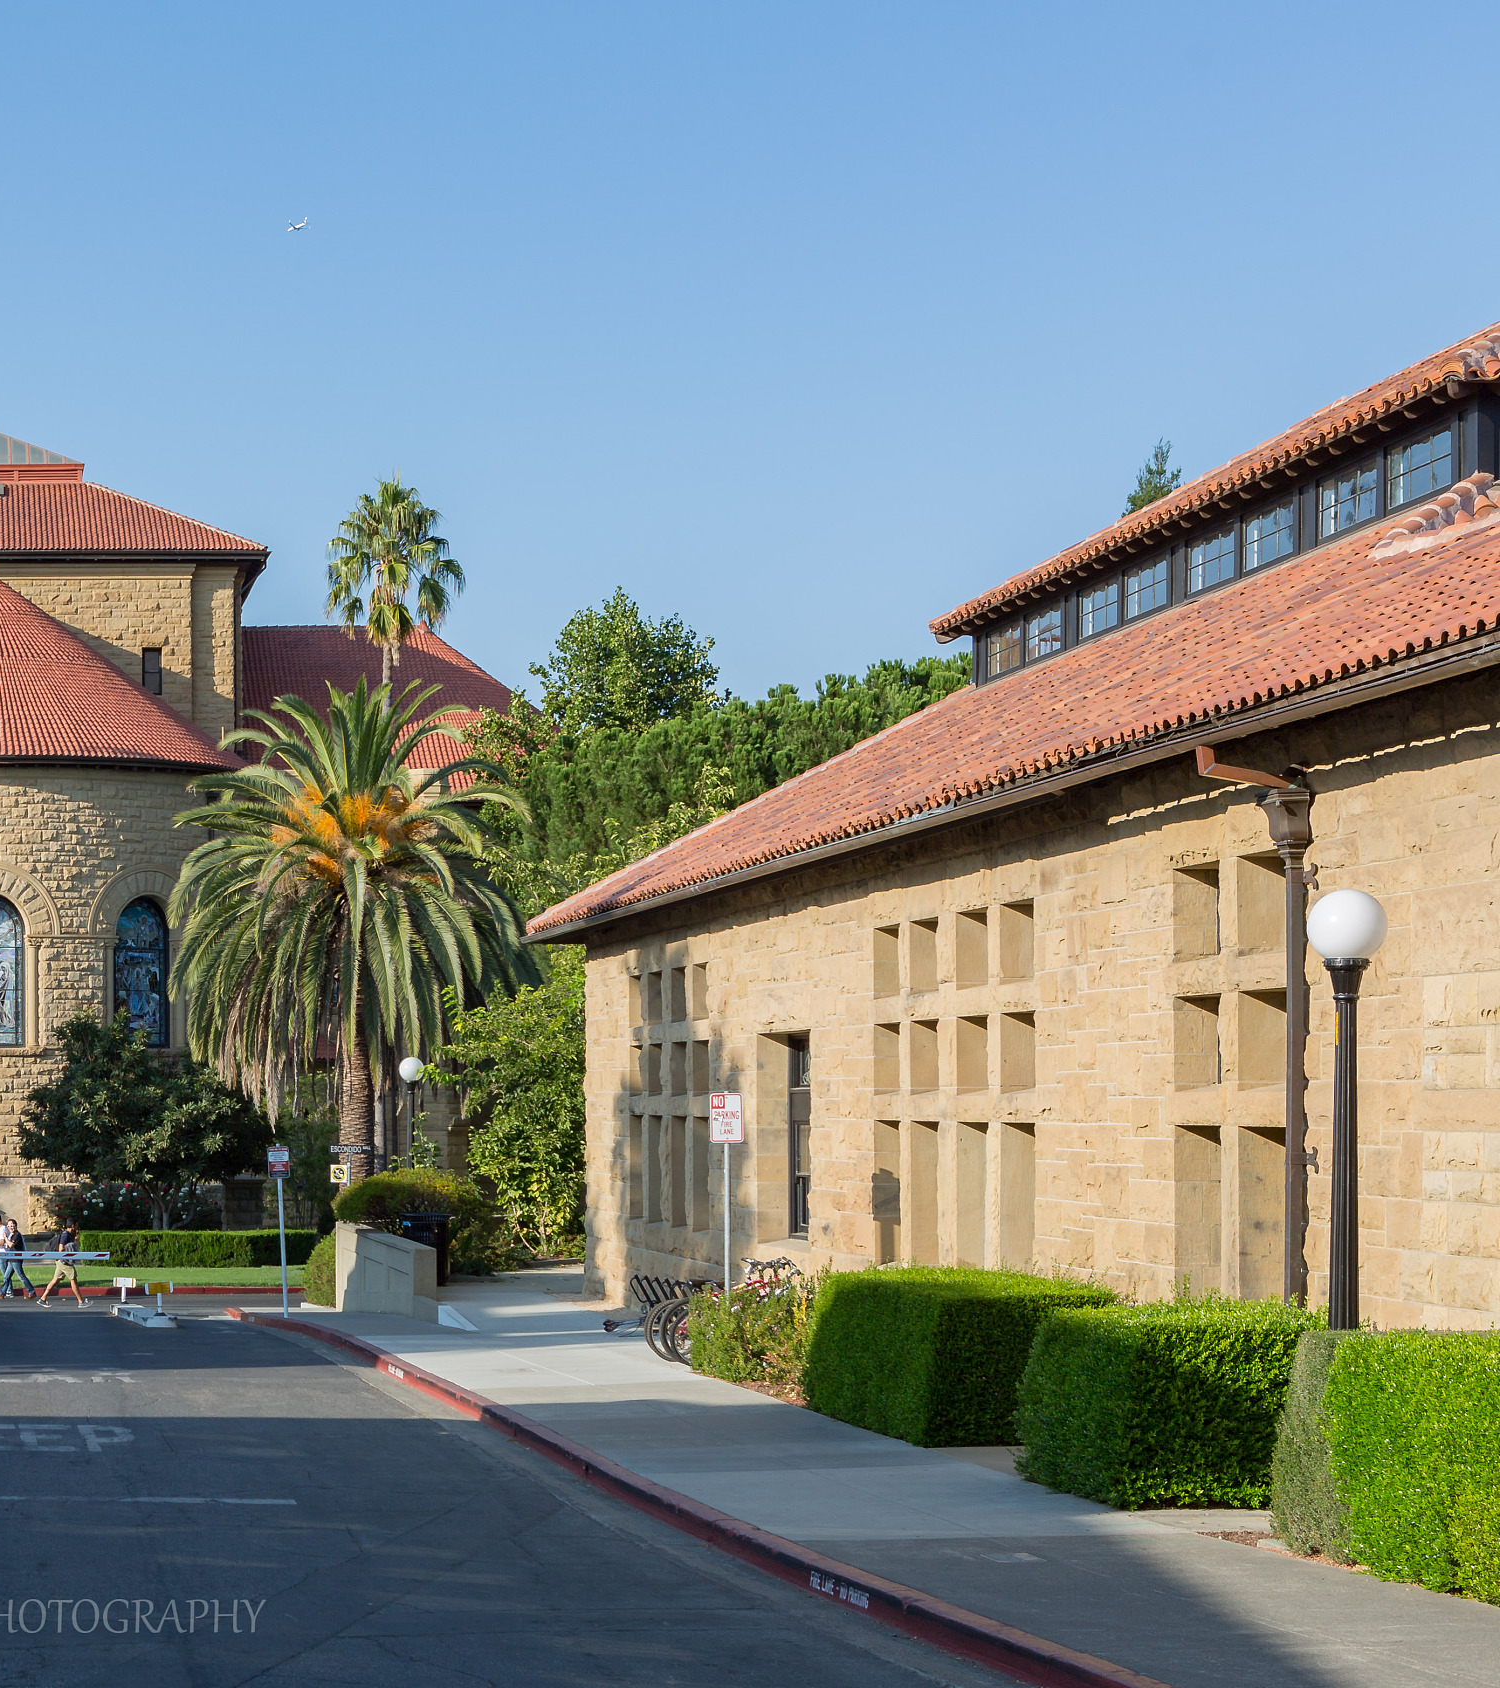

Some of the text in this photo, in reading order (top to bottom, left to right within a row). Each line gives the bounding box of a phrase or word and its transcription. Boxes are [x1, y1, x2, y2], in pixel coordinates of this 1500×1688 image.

[713, 1096, 724, 1108] NO
[713, 1110, 740, 1120] PARKING
[330, 1145, 362, 1153] ESCONDIDO
[810, 1571, 821, 1590] FIRE
[821, 1574, 835, 1596] LANE
[839, 1582, 848, 1600] NO
[848, 1586, 870, 1609] PARKING
